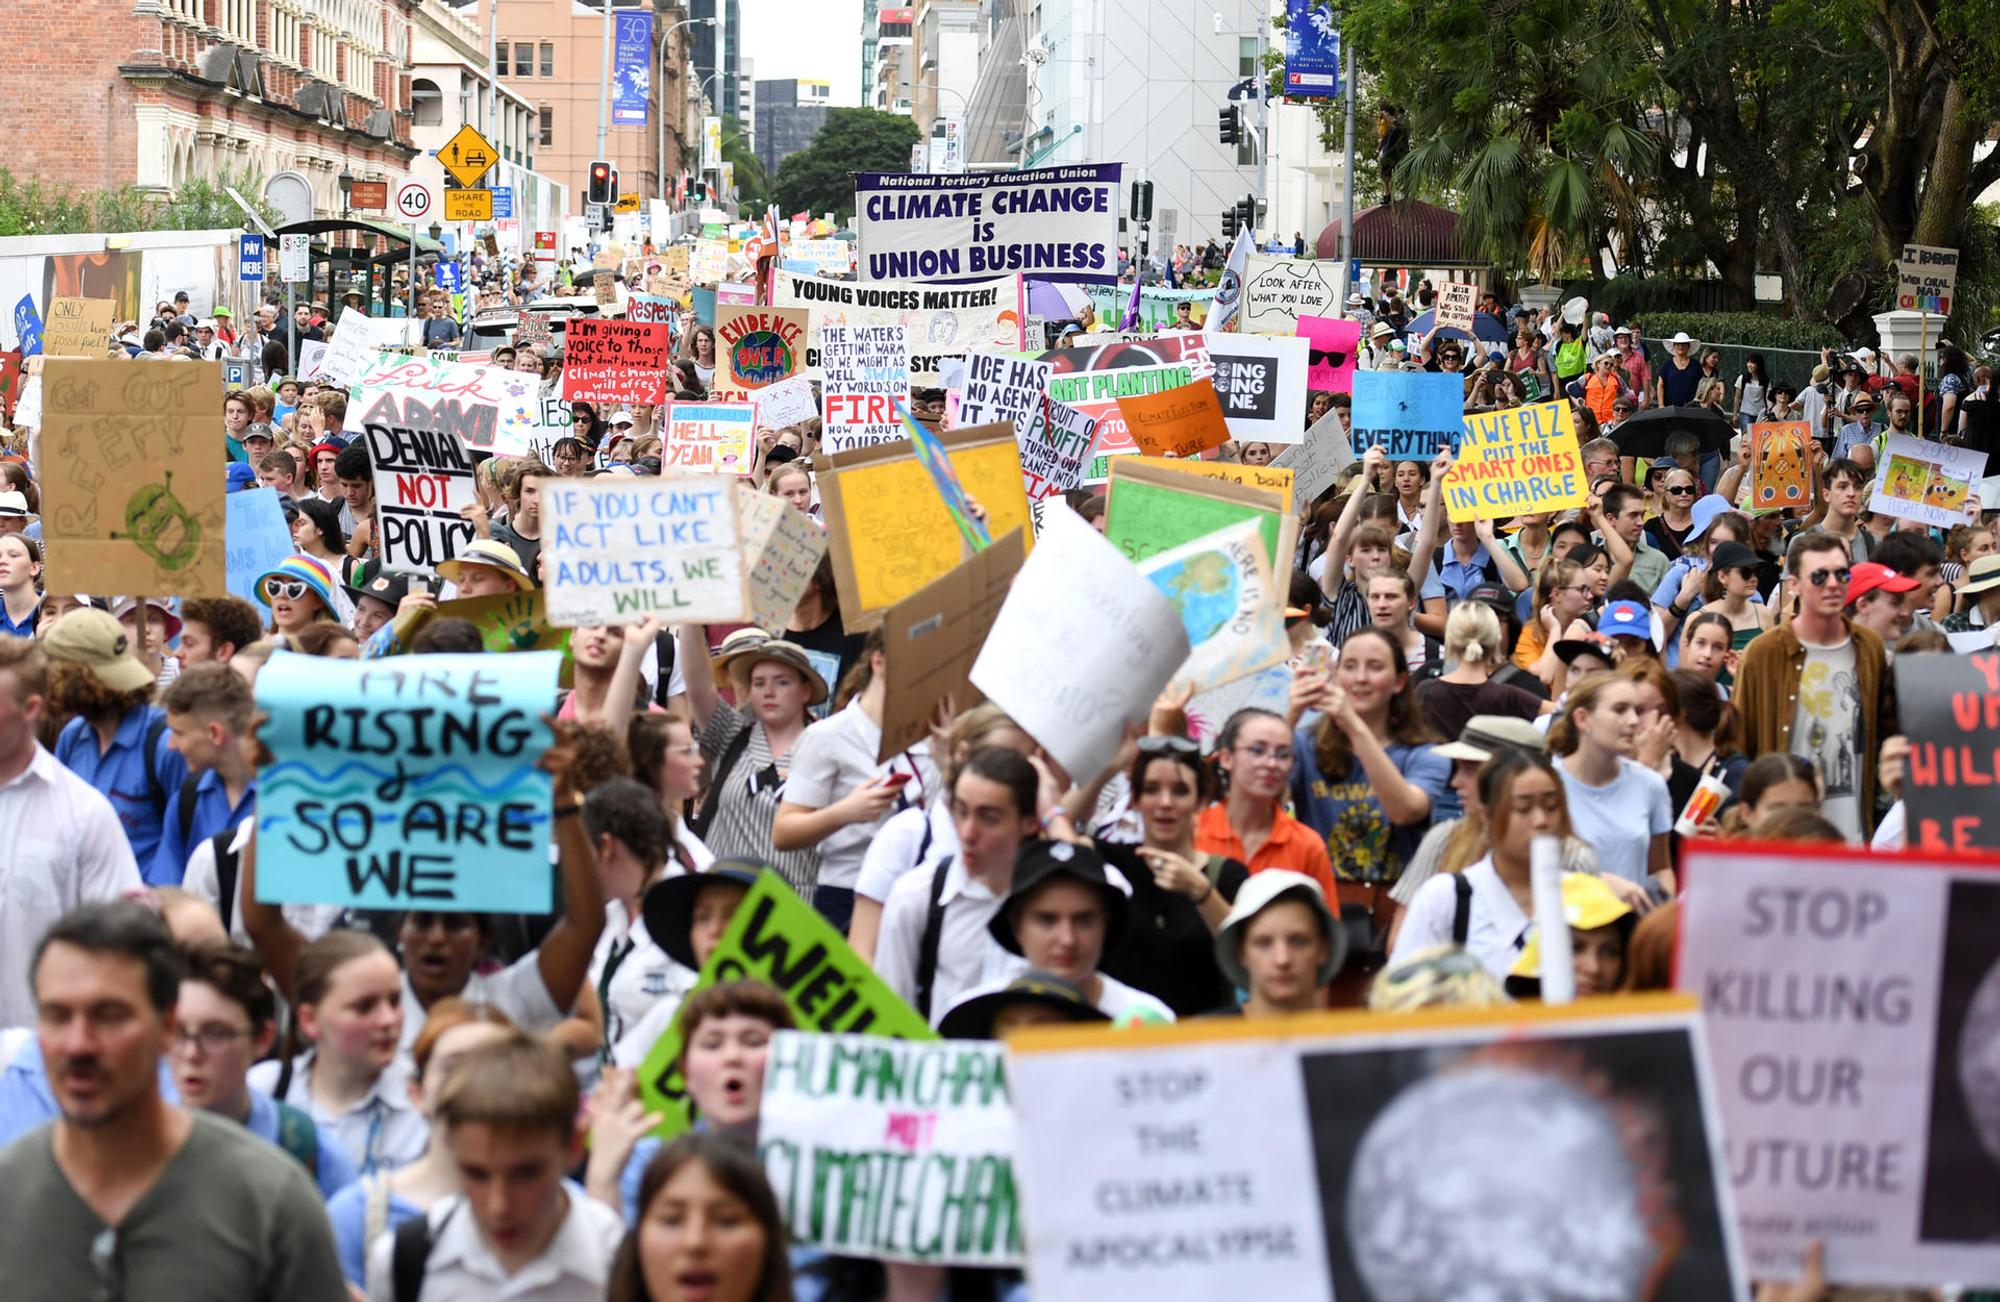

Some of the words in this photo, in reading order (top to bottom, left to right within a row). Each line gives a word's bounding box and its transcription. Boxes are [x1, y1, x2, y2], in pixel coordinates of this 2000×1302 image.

[620, 17, 647, 43] 30
[879, 174, 936, 187] National
[940, 174, 990, 188] Tertiary
[993, 170, 1055, 185] Education
[1059, 167, 1097, 179] Union
[402, 192, 427, 209] 40
[452, 193, 485, 201] SHARE
[867, 192, 983, 222] CLIMATE
[991, 186, 1109, 216] CHANGE
[455, 209, 482, 217] ROAD
[972, 217, 995, 242] is
[243, 242, 260, 256] PAY
[869, 248, 961, 280] UNION
[969, 242, 1106, 273] BUSINESS
[1903, 247, 1917, 264] I
[241, 261, 263, 275] HERE
[792, 278, 853, 304] YOUNG
[856, 288, 920, 310] VOICES
[923, 287, 998, 310] MATTER!
[1259, 277, 1286, 289] LOOK
[1291, 279, 1322, 291] AFTER
[1451, 285, 1469, 294] WISH
[54, 300, 86, 318] ONLY
[1250, 293, 1278, 303] WHAT
[1282, 294, 1298, 305] YOU
[1301, 294, 1323, 306] LOVE
[1439, 302, 1452, 311] WAS
[568, 319, 597, 337] I'm
[602, 325, 641, 339] giving
[643, 327, 652, 337] a
[1451, 312, 1473, 321] OPTION
[718, 313, 803, 347] EVIDENCE
[822, 328, 846, 343] THE
[853, 327, 904, 342] WATER'S
[567, 339, 604, 354] voice
[608, 337, 622, 354] to
[627, 339, 664, 356] those
[737, 346, 785, 367] OVER
[825, 343, 871, 357] GETTING
[875, 343, 906, 355] WARM
[566, 352, 593, 367] that
[621, 355, 649, 368] have
[650, 355, 660, 369] 1
[568, 366, 617, 381] Climate
[823, 357, 834, 369] SO
[838, 357, 851, 368] WE
[857, 356, 889, 368] MIGHT
[892, 355, 905, 367] AS
[970, 354, 1005, 384] ICE
[1009, 360, 1048, 391] HAS
[230, 368, 240, 381] P
[362, 363, 502, 402] Fuck
[592, 380, 617, 391] will
[621, 378, 662, 392] affect
[825, 369, 856, 381] WELL
[864, 368, 907, 381] SWIM
[825, 382, 842, 394] MY
[847, 381, 891, 393] WORLD'S
[893, 382, 908, 393] ON
[1093, 366, 1192, 398] PLANTING
[573, 390, 640, 404] animals
[644, 390, 657, 404] 2
[966, 382, 987, 403] NO
[990, 386, 1036, 410] AGEN
[1360, 377, 1455, 402] EARTH
[826, 395, 906, 424] FIRE
[960, 403, 983, 424] IT
[1035, 394, 1080, 428] PURSUIT
[1084, 418, 1096, 437] O
[672, 422, 721, 441] HELL
[828, 425, 852, 435] HOW
[864, 424, 900, 435] ABOUT
[1103, 420, 1129, 436] STO
[1480, 415, 1512, 443] WE
[1518, 405, 1564, 440] PLZ
[364, 423, 473, 471] DENIAL
[1027, 416, 1091, 461] PROFIT
[1352, 428, 1461, 456] EVERYTHING
[1483, 445, 1515, 462] PUT
[1519, 440, 1550, 456] THE
[669, 443, 713, 466] YEAH
[1025, 439, 1059, 464] TURNED
[1061, 456, 1082, 476] OUR
[1447, 458, 1516, 483] SMART
[1521, 451, 1575, 476] ONES
[1019, 452, 1056, 478] PLANET
[1053, 469, 1074, 488] INTO
[396, 474, 451, 509] NOT
[1450, 486, 1478, 509] IN
[1483, 474, 1576, 505] CHARGE
[553, 491, 577, 515] IF
[589, 492, 639, 519] YOU
[555, 523, 613, 549] ACT
[635, 521, 712, 547] LIKE
[682, 557, 725, 580] WE
[613, 588, 692, 614] WILL
[304, 704, 533, 758] RISING
[1910, 742, 2000, 787] WIL
[286, 801, 373, 855] SO
[402, 800, 536, 850] ARE
[1919, 816, 1982, 855] BE
[345, 850, 457, 900] WE
[1742, 884, 1889, 941] STOP
[1702, 967, 1914, 1027] KILLING
[1115, 1068, 1208, 1107] STOP
[1738, 1053, 1864, 1107] OUR
[885, 1110, 939, 1152] NOT
[1135, 1120, 1202, 1155] THE
[1094, 1171, 1254, 1215] CLIMATE
[1065, 1224, 1297, 1272] APOCALYPSE
